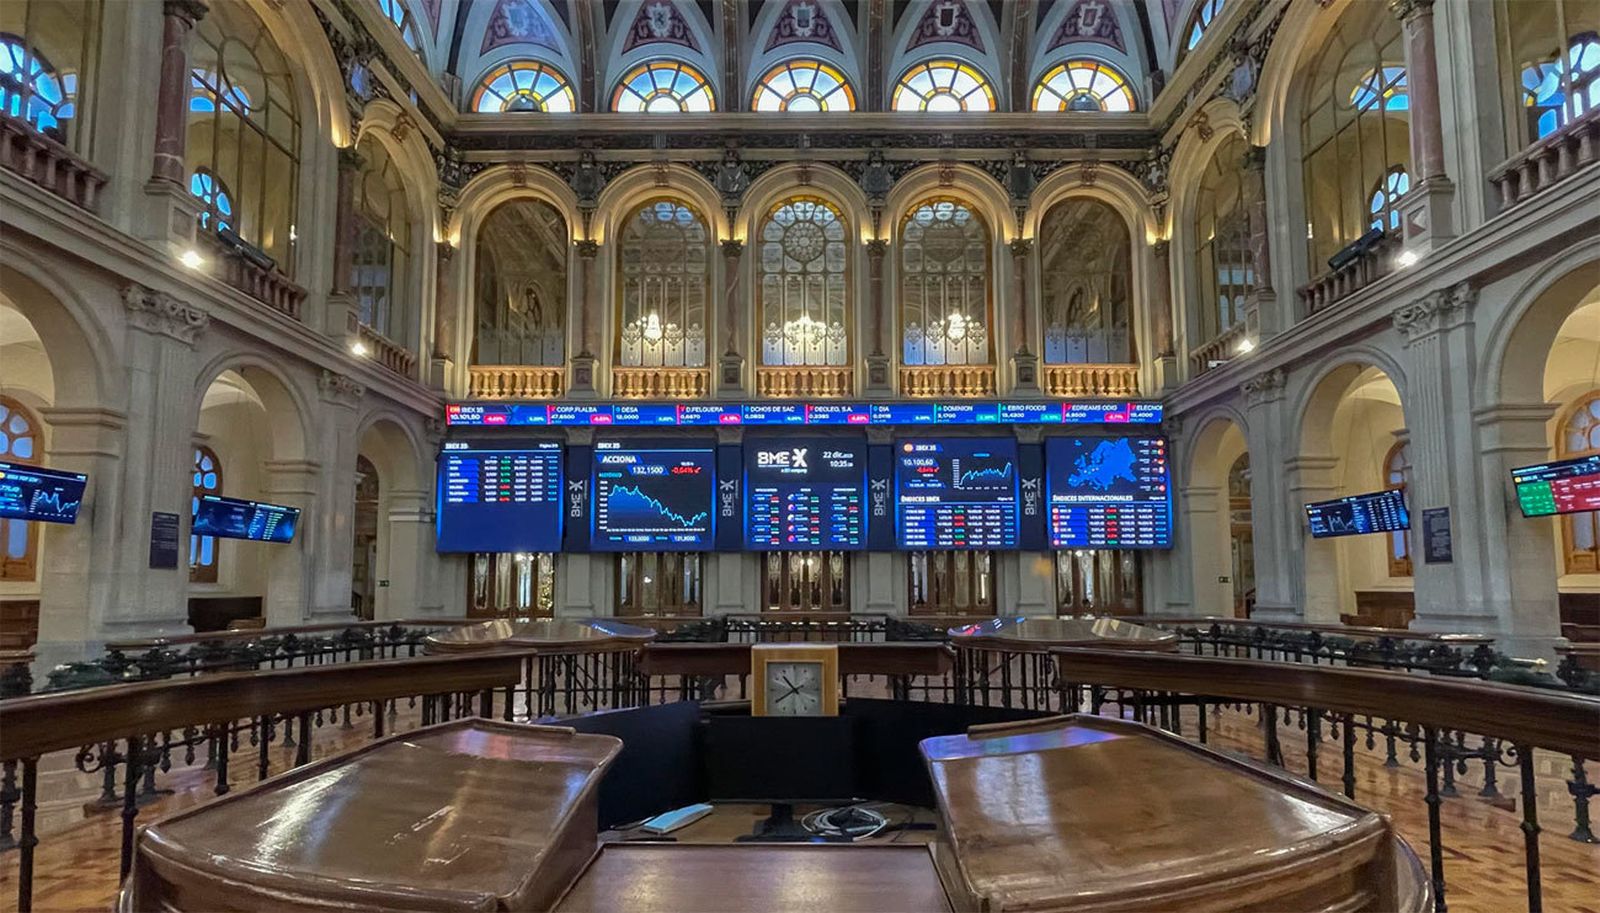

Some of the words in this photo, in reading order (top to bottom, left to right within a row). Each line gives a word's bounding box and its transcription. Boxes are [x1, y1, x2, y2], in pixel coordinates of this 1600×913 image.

[602, 455, 637, 463] ACCIONA
[757, 451, 790, 465] BME
[570, 493, 582, 518] BME
[722, 493, 732, 517] BME
[873, 492, 884, 516] BME
[1025, 491, 1035, 515] BME
